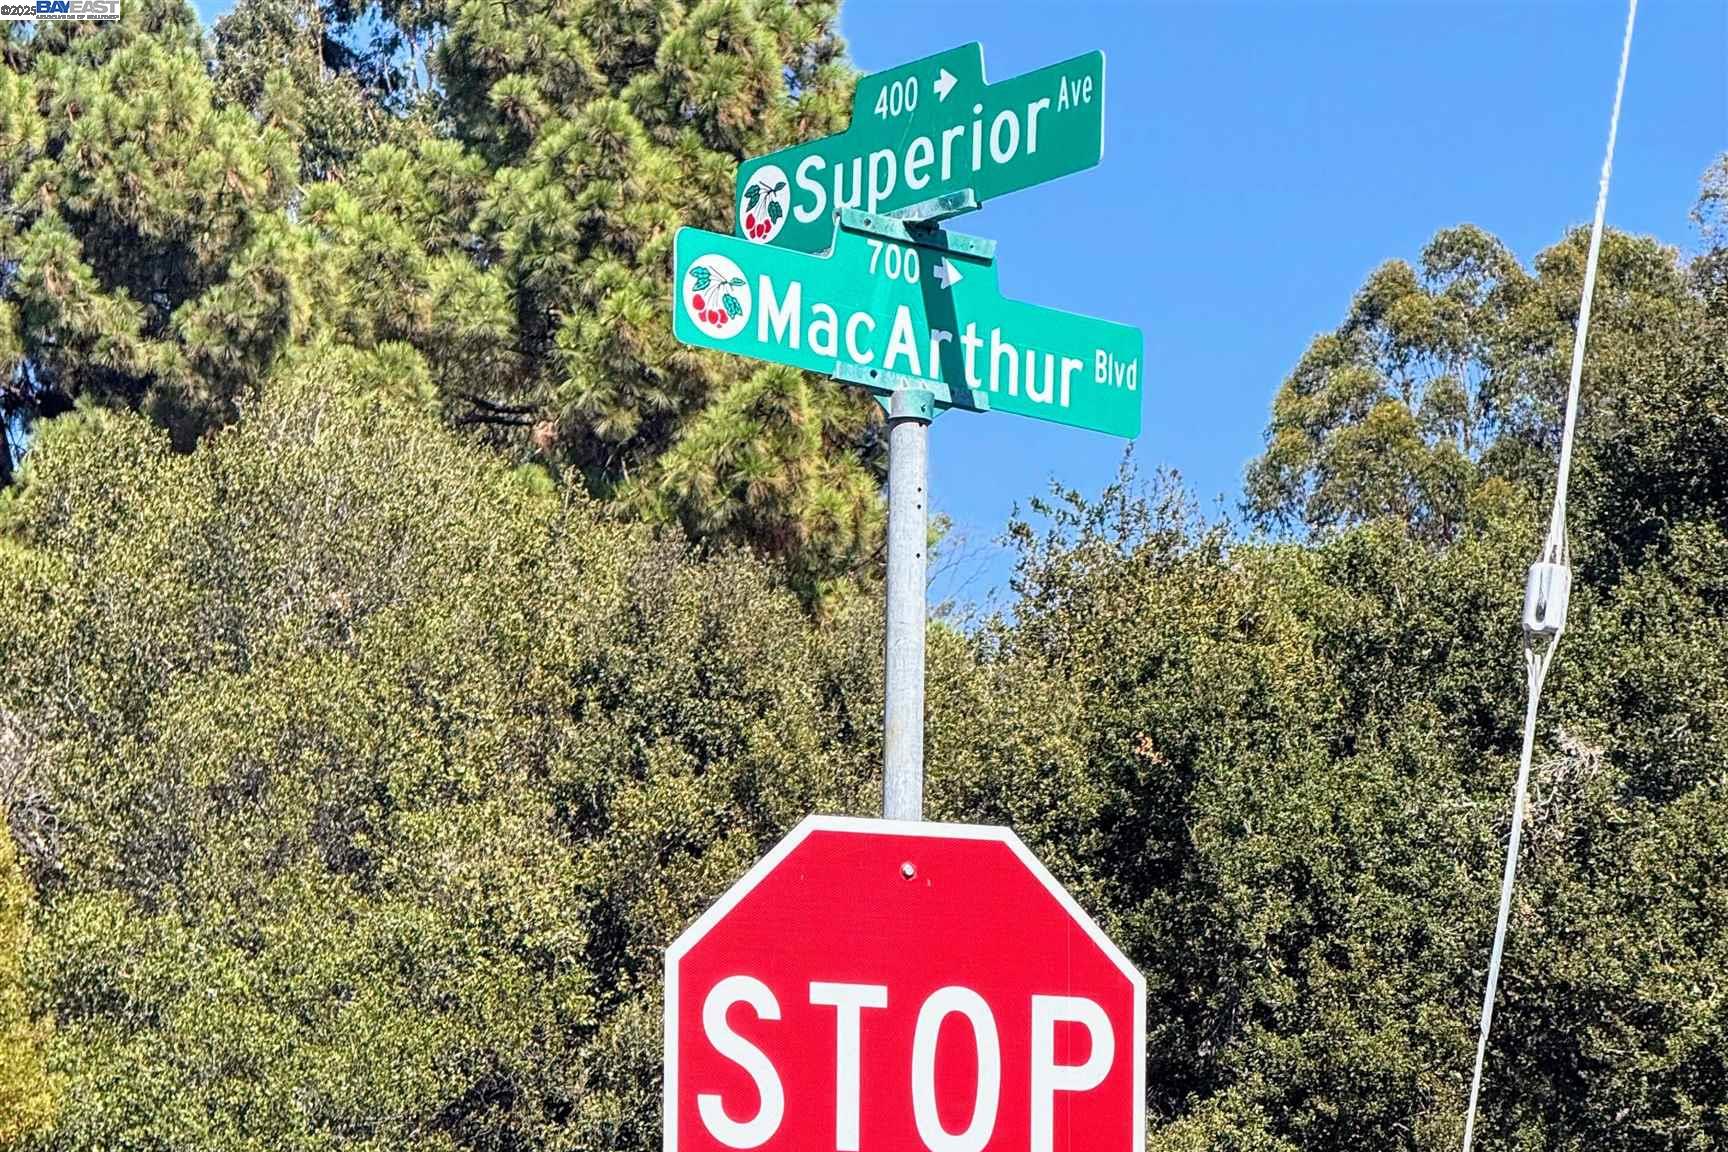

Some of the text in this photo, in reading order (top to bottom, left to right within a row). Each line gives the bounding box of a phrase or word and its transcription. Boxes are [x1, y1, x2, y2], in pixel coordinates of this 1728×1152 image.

[874, 76, 919, 120] 400
[793, 74, 1094, 223] Superior Ave
[866, 238, 921, 285] 700
[757, 274, 1138, 408] MacArthur Blvd
